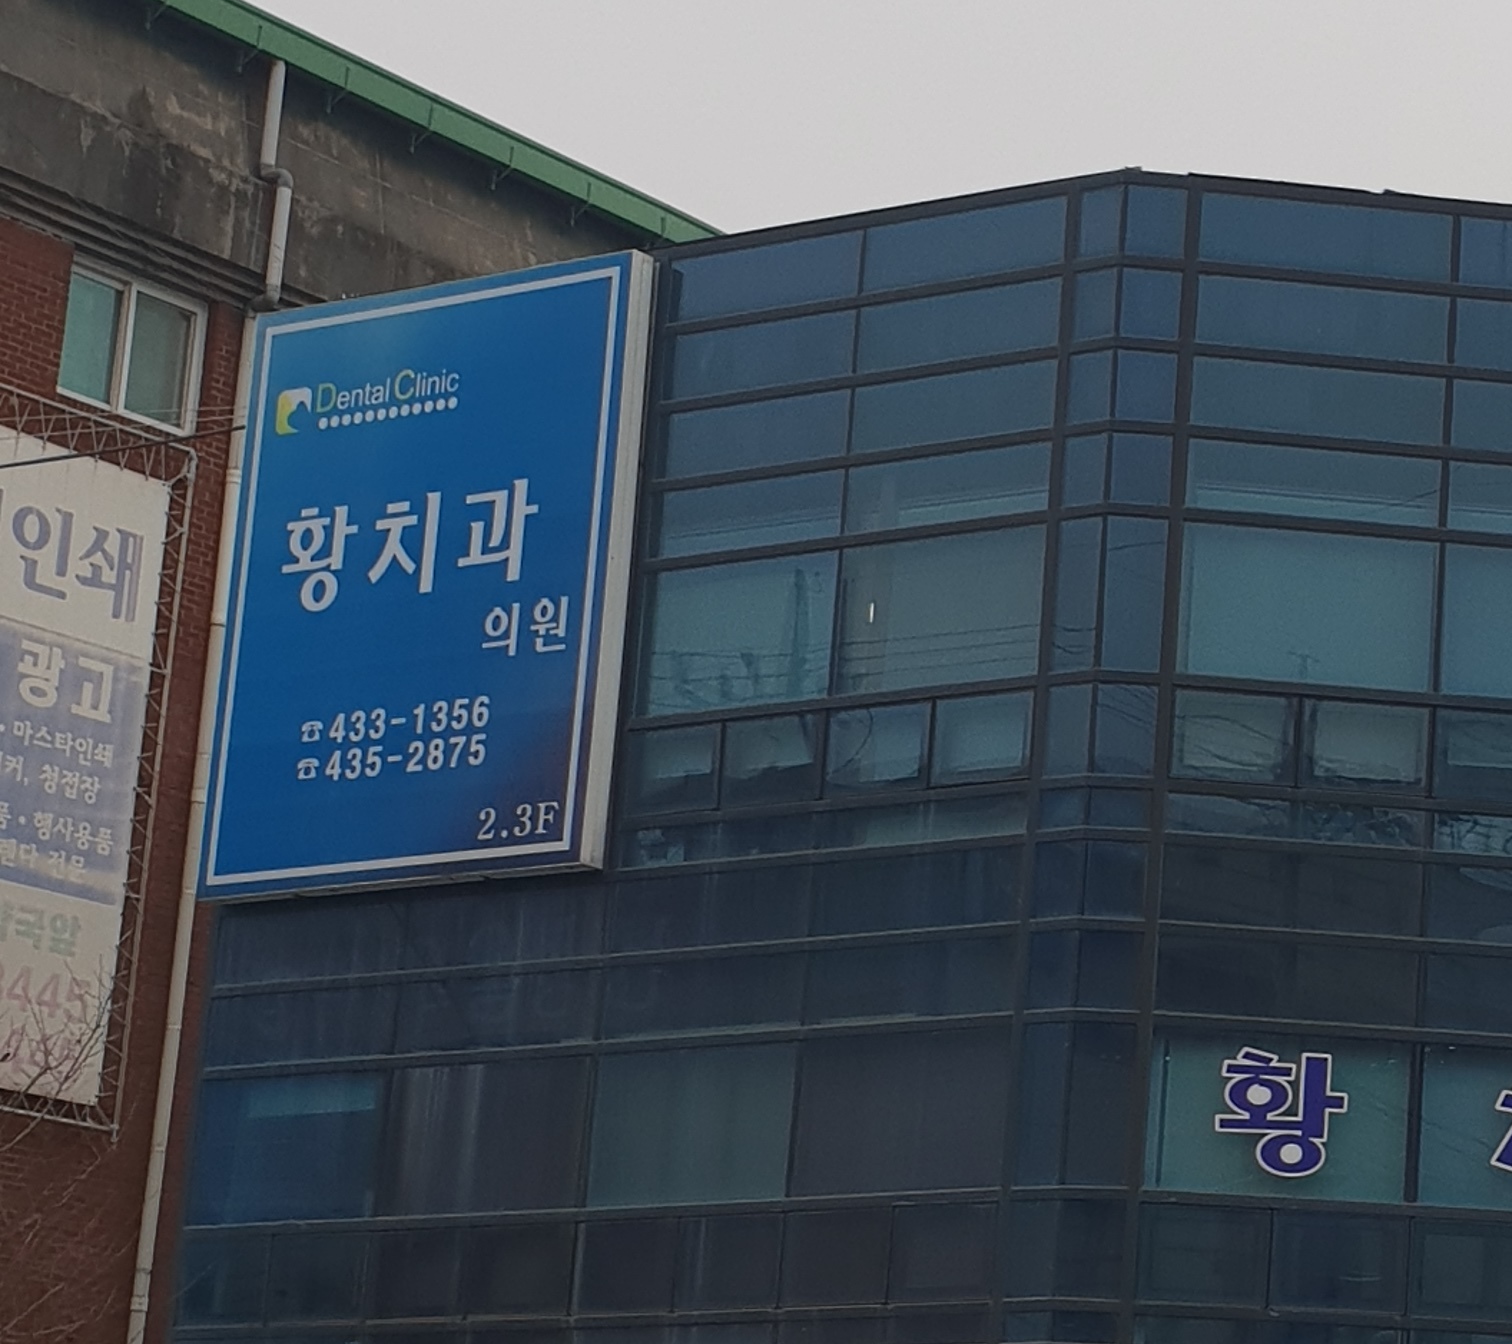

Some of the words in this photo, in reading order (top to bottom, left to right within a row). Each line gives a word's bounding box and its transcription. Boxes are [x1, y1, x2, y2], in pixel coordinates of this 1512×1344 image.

[316, 377, 391, 413] Dental
[394, 369, 460, 401] Clinic
[281, 478, 539, 612] 황치과
[482, 596, 570, 657] 의원
[18, 639, 115, 723] 광고
[328, 695, 490, 744] 433-1356
[325, 733, 487, 781] 435-2875
[477, 801, 559, 841] 2.3F
